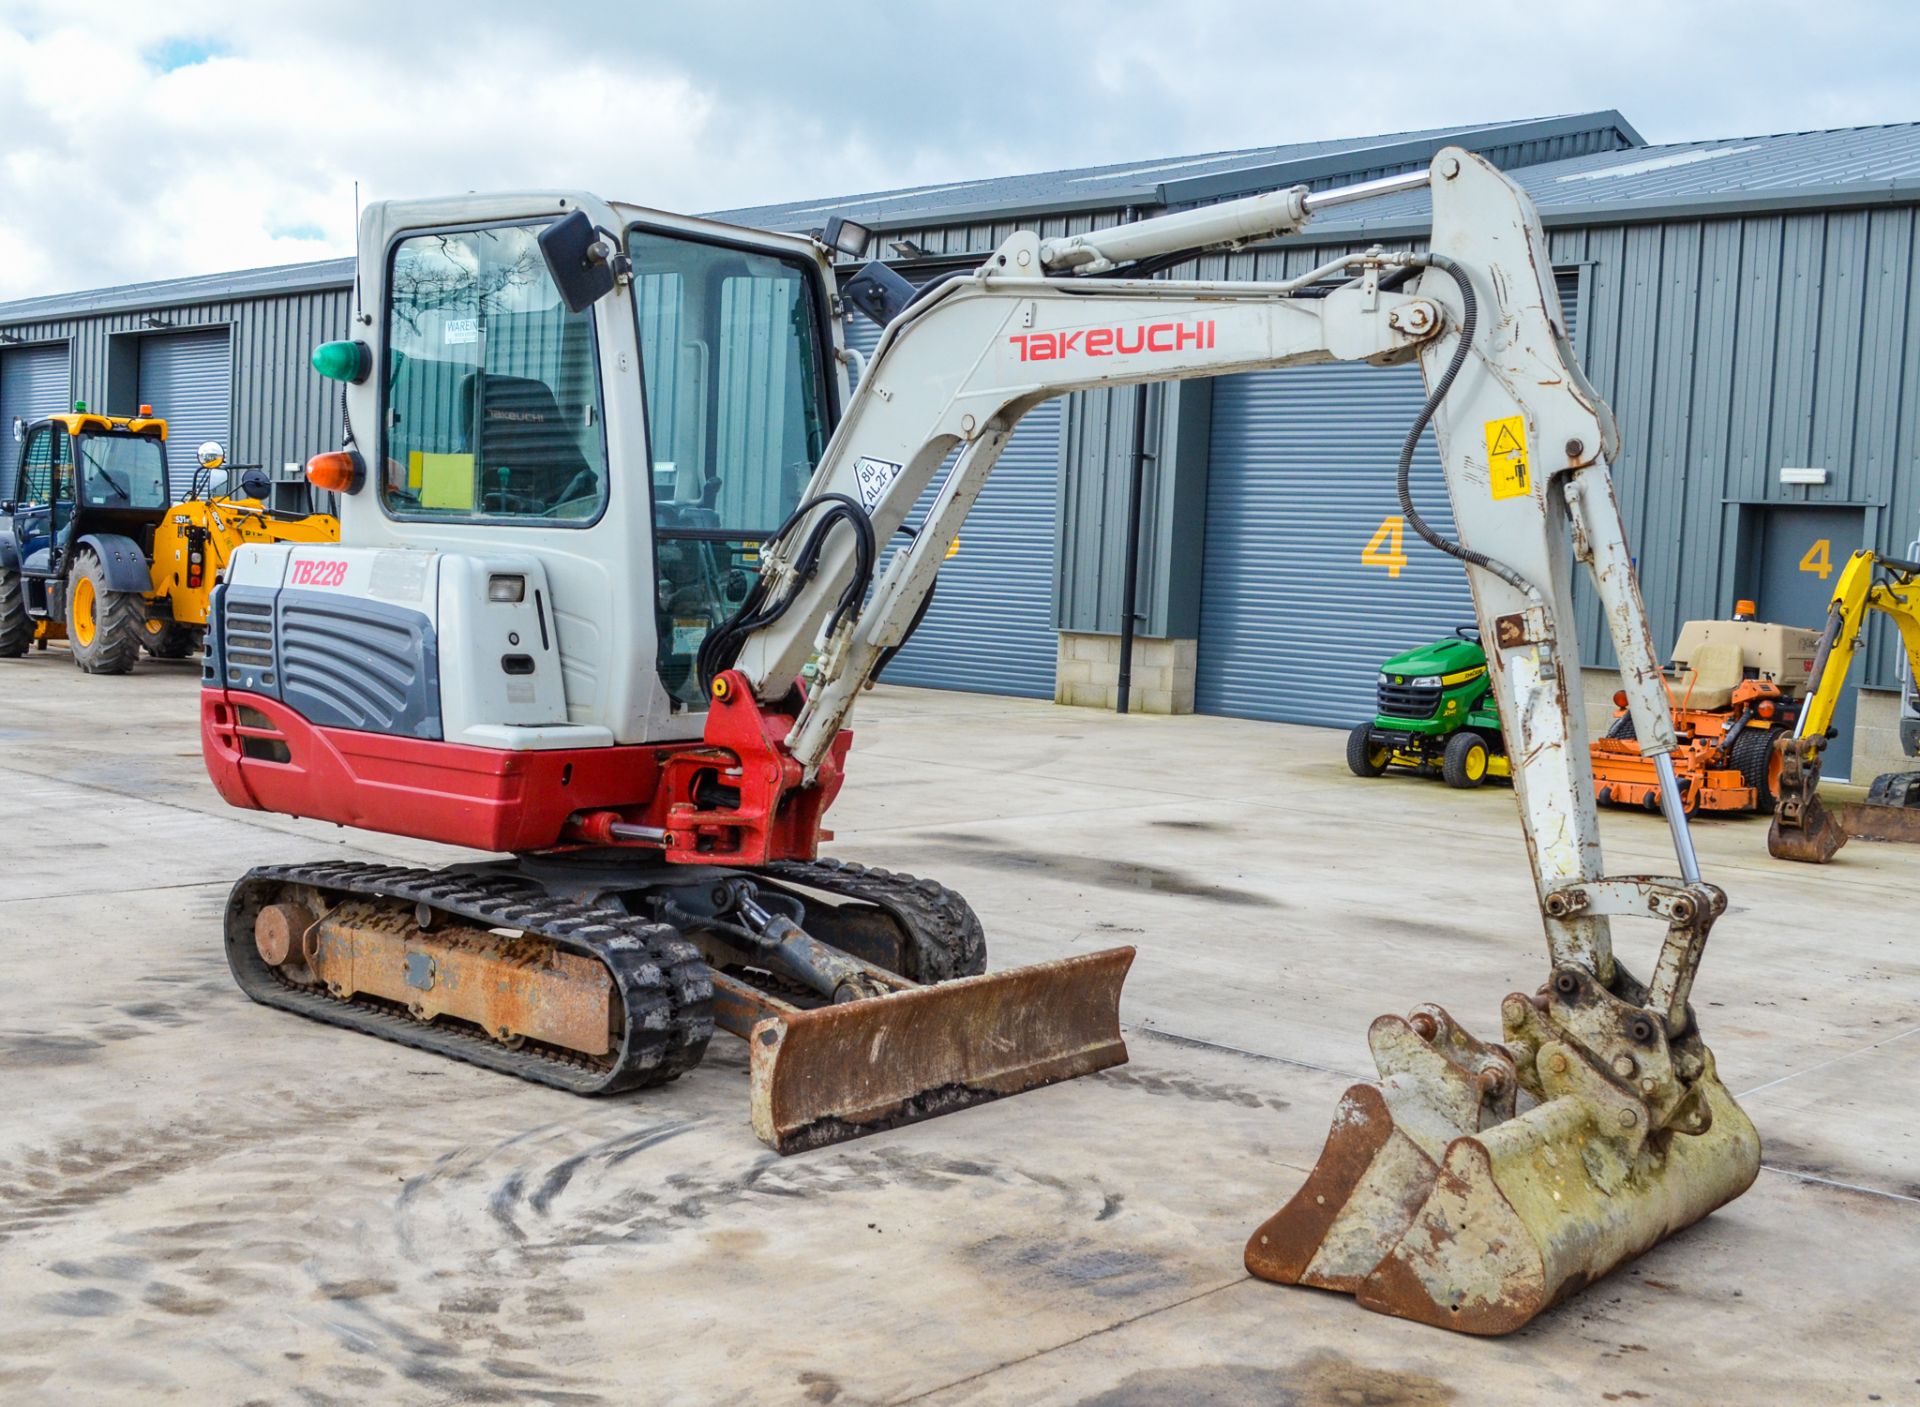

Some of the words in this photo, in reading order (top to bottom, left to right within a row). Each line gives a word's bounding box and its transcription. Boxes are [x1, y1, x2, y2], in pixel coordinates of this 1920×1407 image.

[866, 467, 887, 502] AL2F
[1361, 515, 1408, 577] 4
[1799, 539, 1833, 580] 4
[291, 559, 348, 586] TB228
